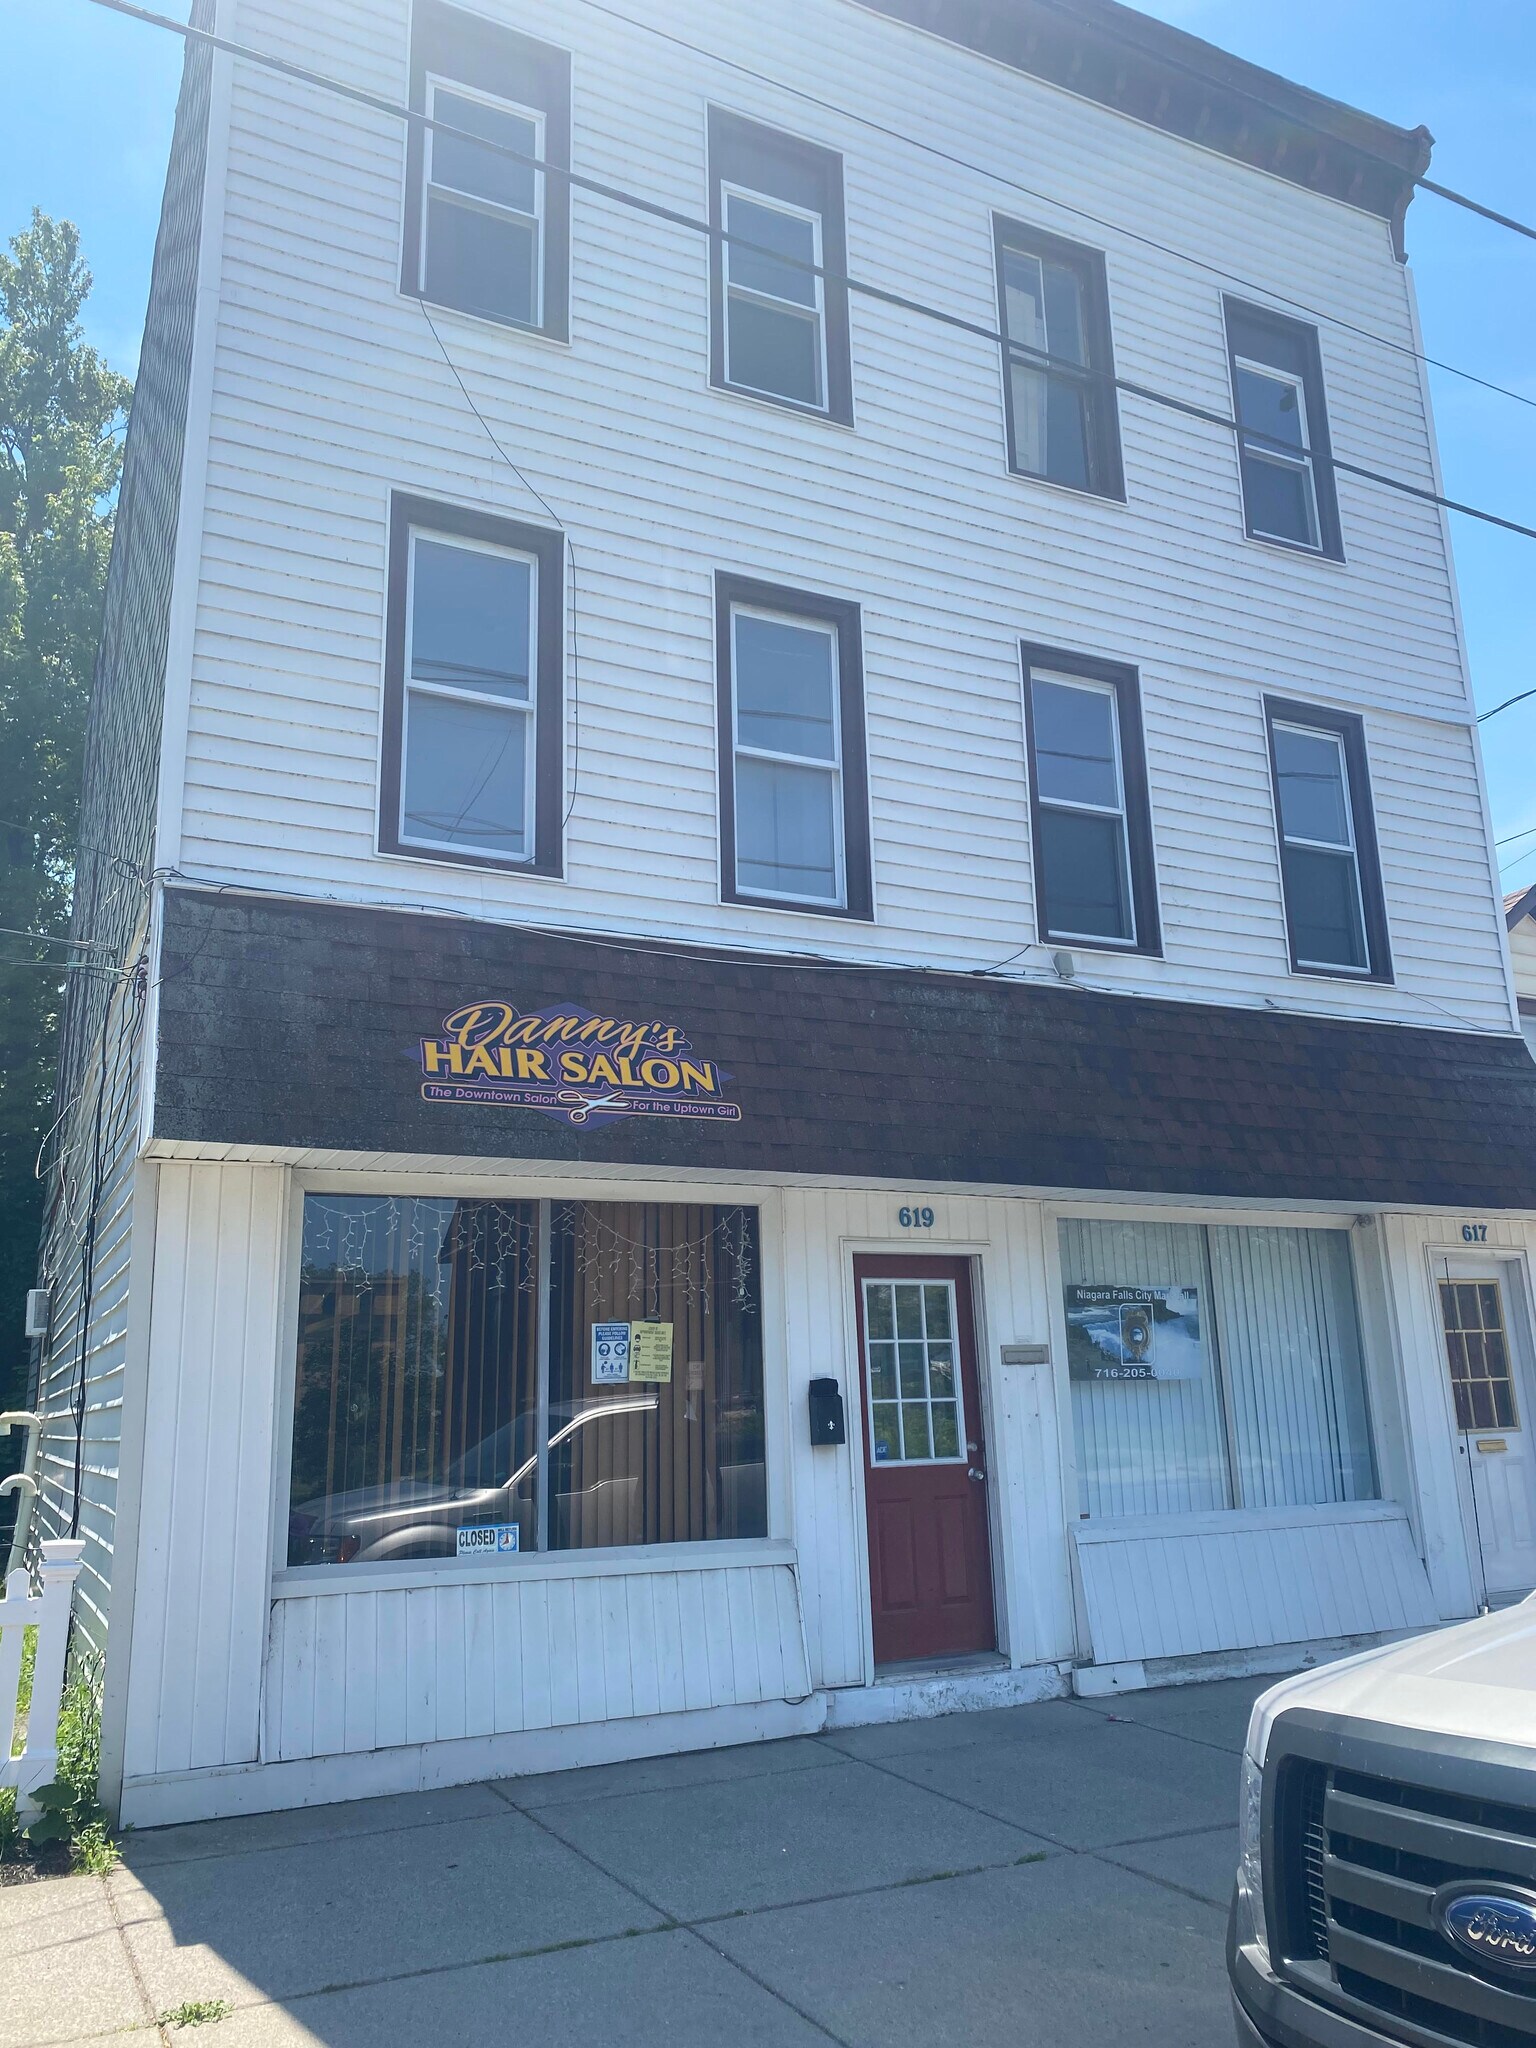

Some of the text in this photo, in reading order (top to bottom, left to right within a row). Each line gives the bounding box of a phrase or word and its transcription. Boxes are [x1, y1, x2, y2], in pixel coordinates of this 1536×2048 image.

[443, 1001, 690, 1065] Danny's
[422, 1039, 719, 1095] HAIR SALON
[429, 1086, 736, 1117] The Downtown Salon For the Uptown Girl
[898, 1206, 935, 1228] 619
[1461, 1223, 1488, 1242] 617
[1076, 1290, 1111, 1301] Niagara
[1112, 1290, 1133, 1300] Falls
[1135, 1290, 1152, 1302] City
[459, 1529, 495, 1547] CLOSED
[1459, 1906, 1536, 1955] Ford
